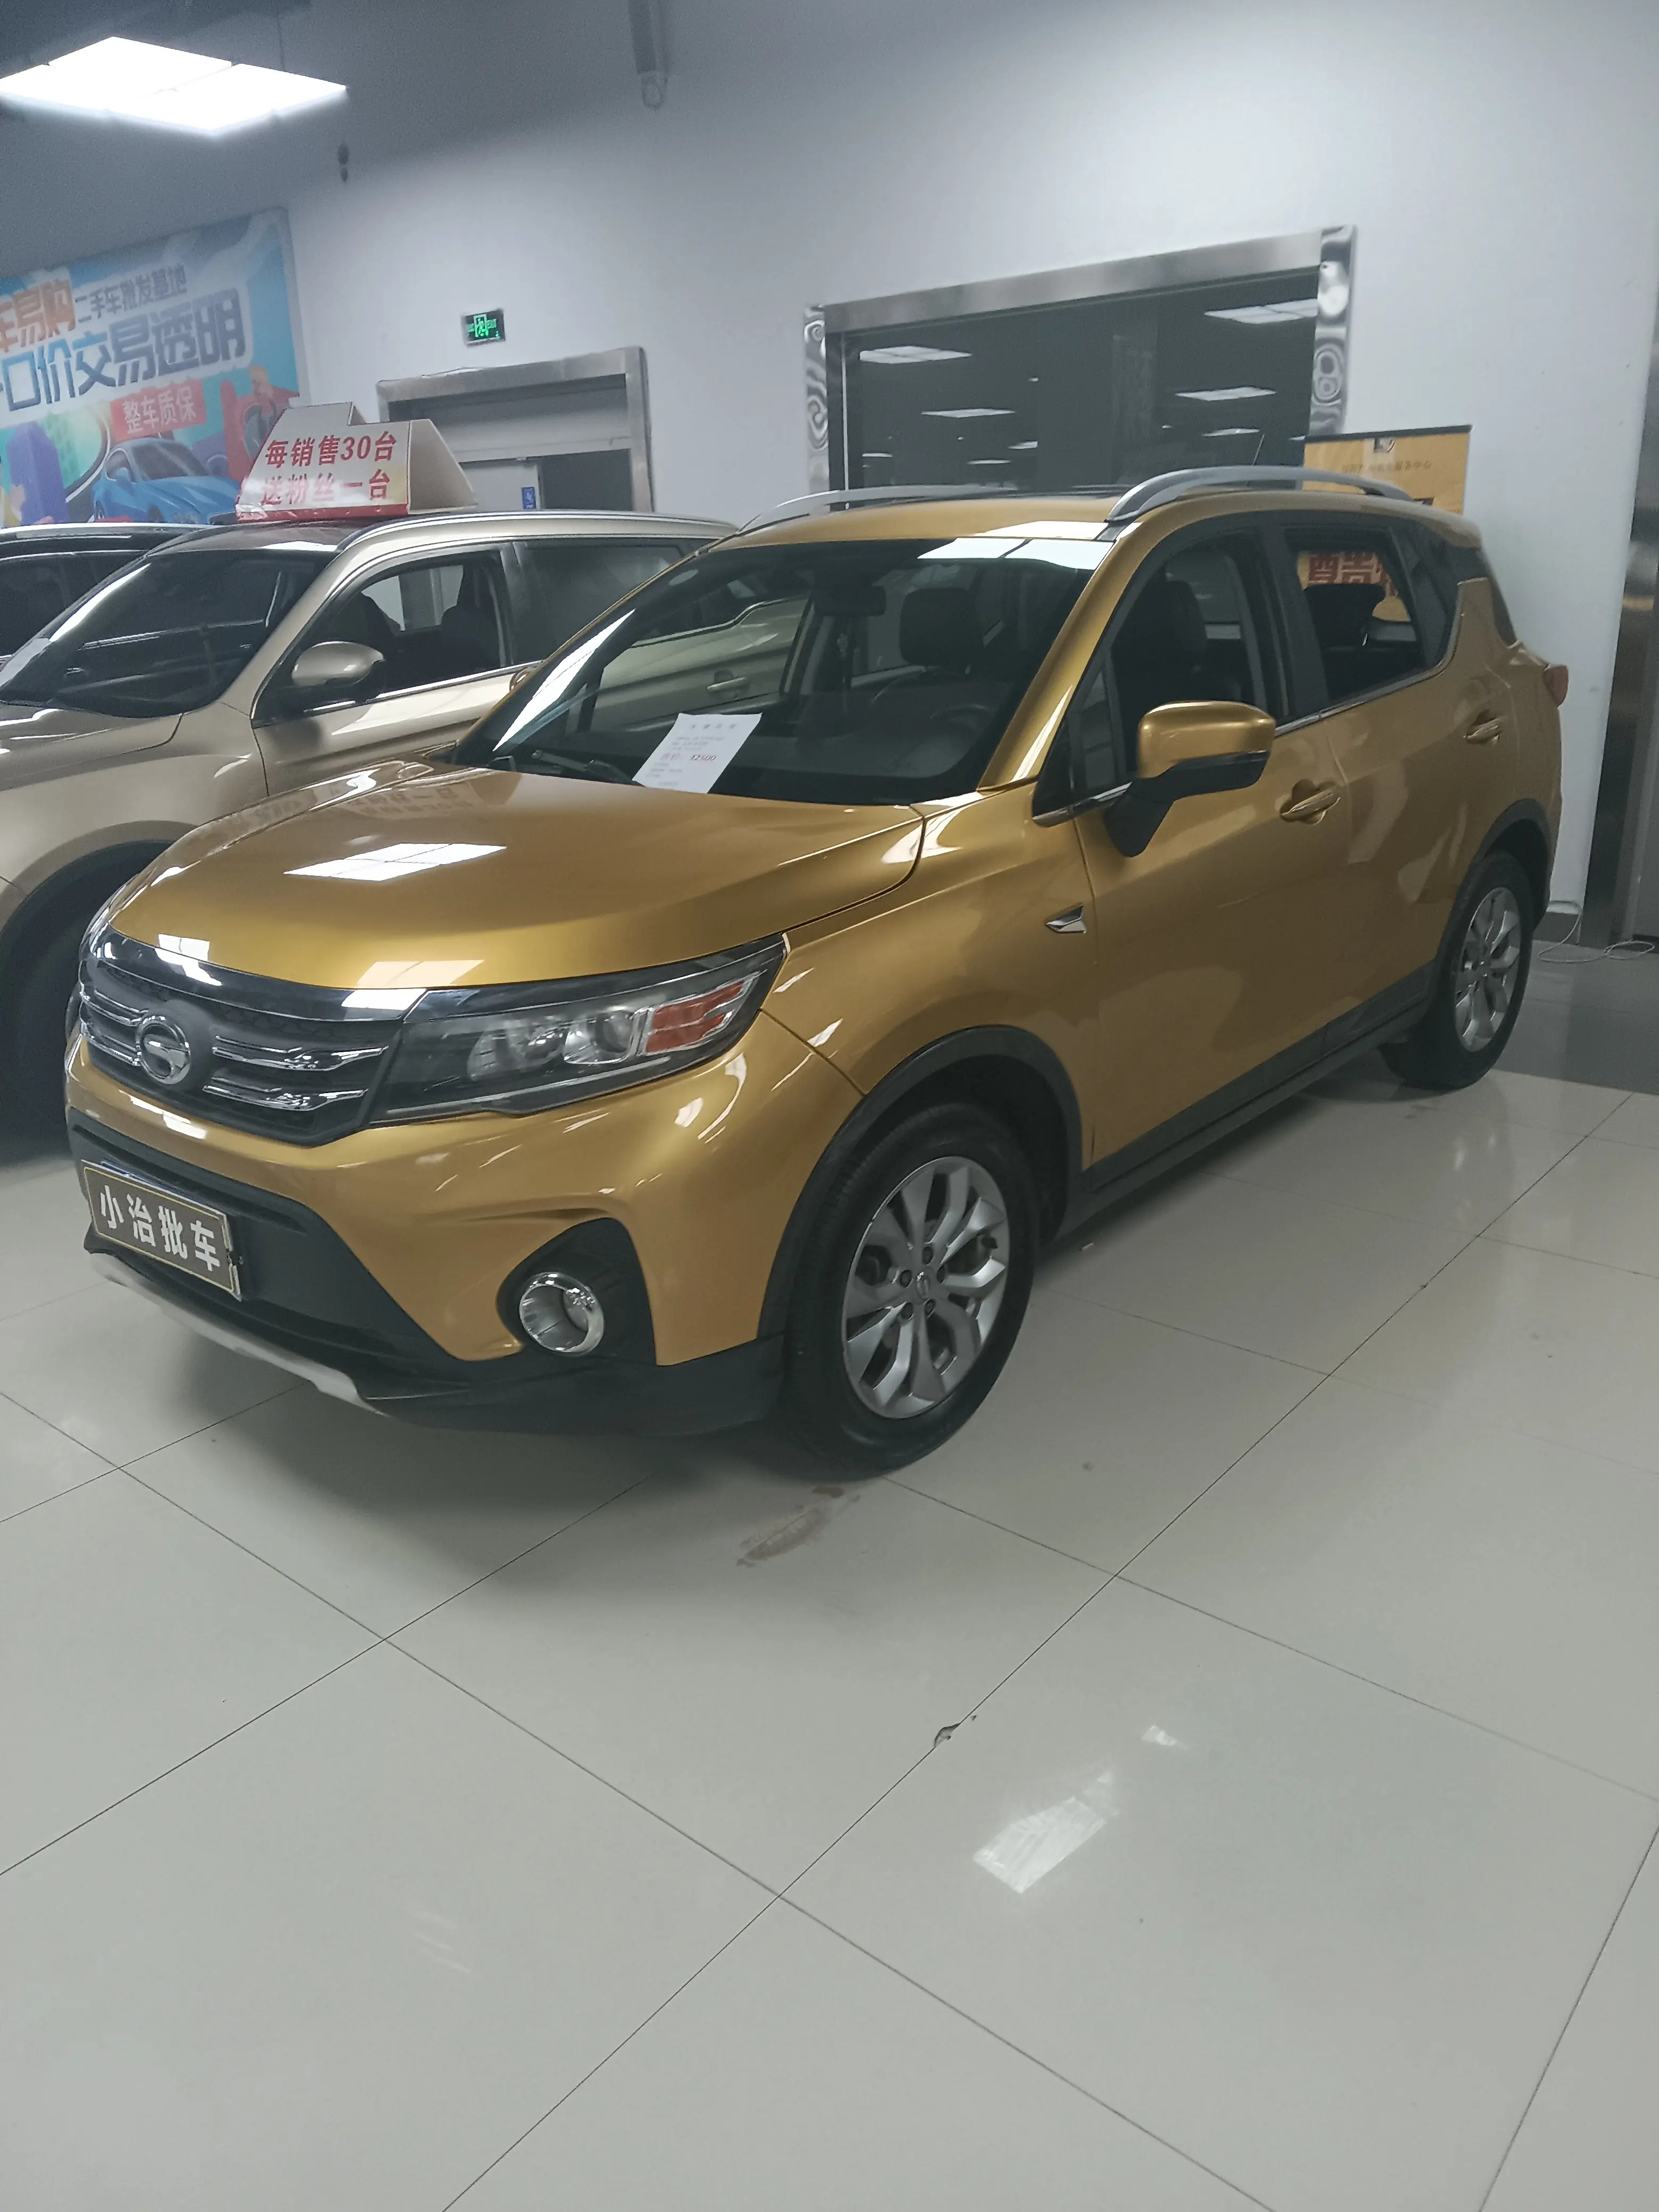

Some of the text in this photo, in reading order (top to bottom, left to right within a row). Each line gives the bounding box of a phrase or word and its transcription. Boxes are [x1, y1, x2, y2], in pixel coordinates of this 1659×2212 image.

[0, 287, 246, 413] 口价交易透明
[122, 385, 197, 434] 整车质保
[265, 430, 397, 469] 每销售30台
[260, 468, 391, 506] 送粉丝一台
[100, 1185, 221, 1272] 小治批车
